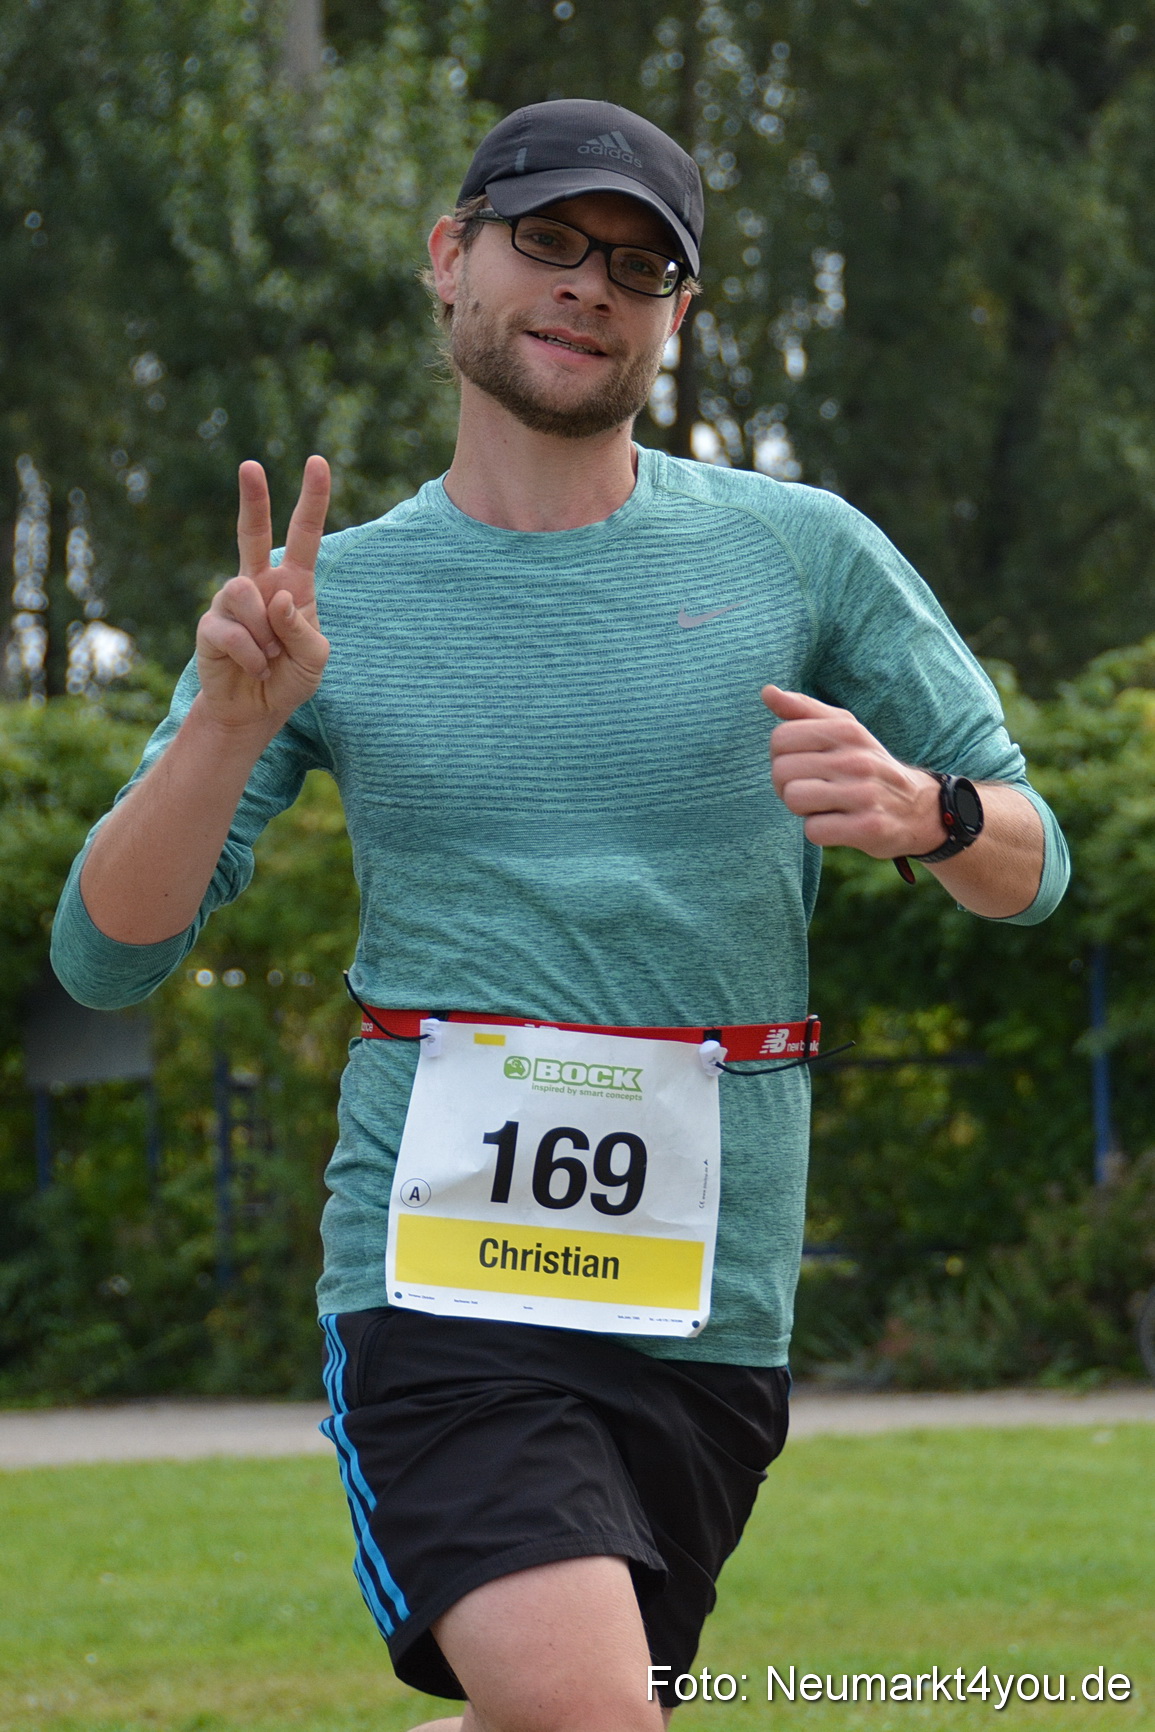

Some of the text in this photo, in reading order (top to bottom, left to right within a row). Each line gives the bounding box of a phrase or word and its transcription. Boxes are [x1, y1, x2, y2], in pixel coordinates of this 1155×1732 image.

[577, 145, 643, 168] adidas
[532, 1058, 644, 1092] BOCK
[531, 1083, 643, 1102] inspired by smart concepts
[482, 1120, 648, 1216] 169
[409, 1186, 420, 1202] A
[479, 1237, 620, 1280] Christian
